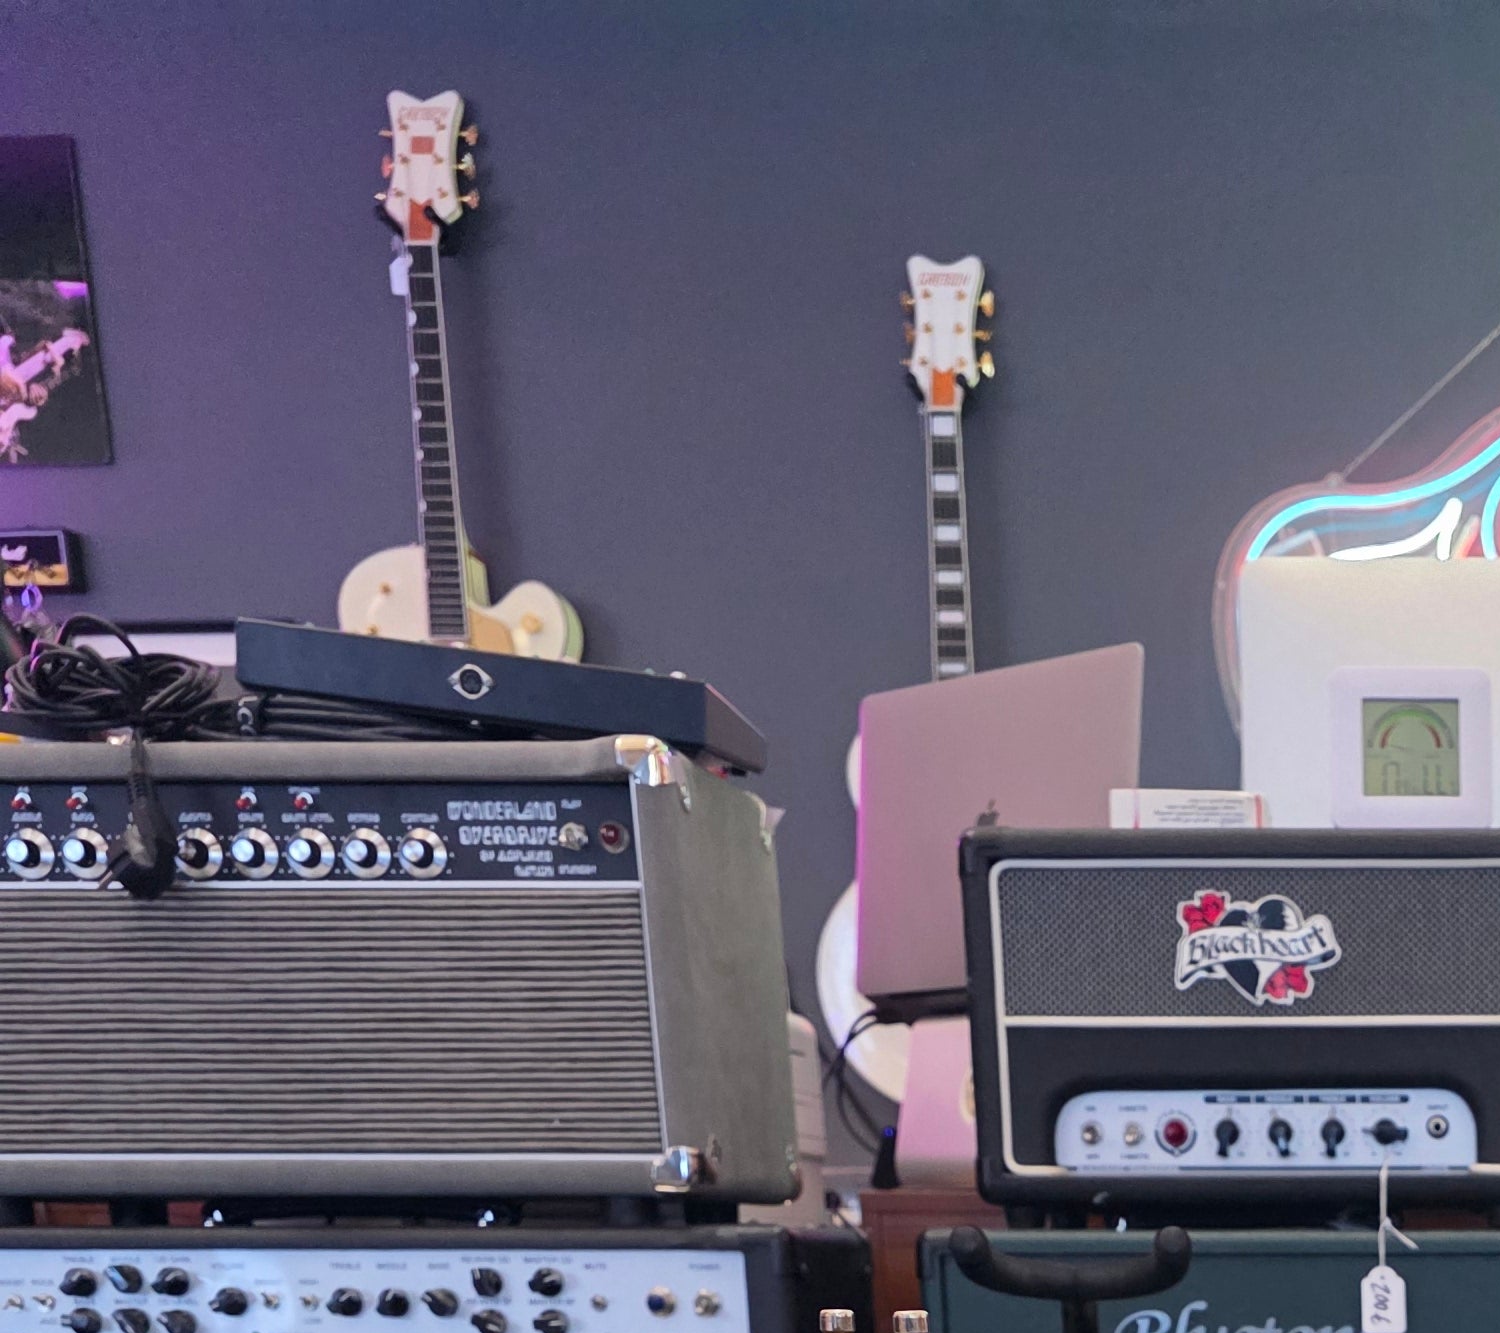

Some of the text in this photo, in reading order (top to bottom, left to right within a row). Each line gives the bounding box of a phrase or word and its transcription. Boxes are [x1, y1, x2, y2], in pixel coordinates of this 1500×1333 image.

[447, 800, 557, 821] WONDERLAND
[458, 825, 558, 845] OVERDRIVE
[1189, 925, 1327, 965] Blackheart
